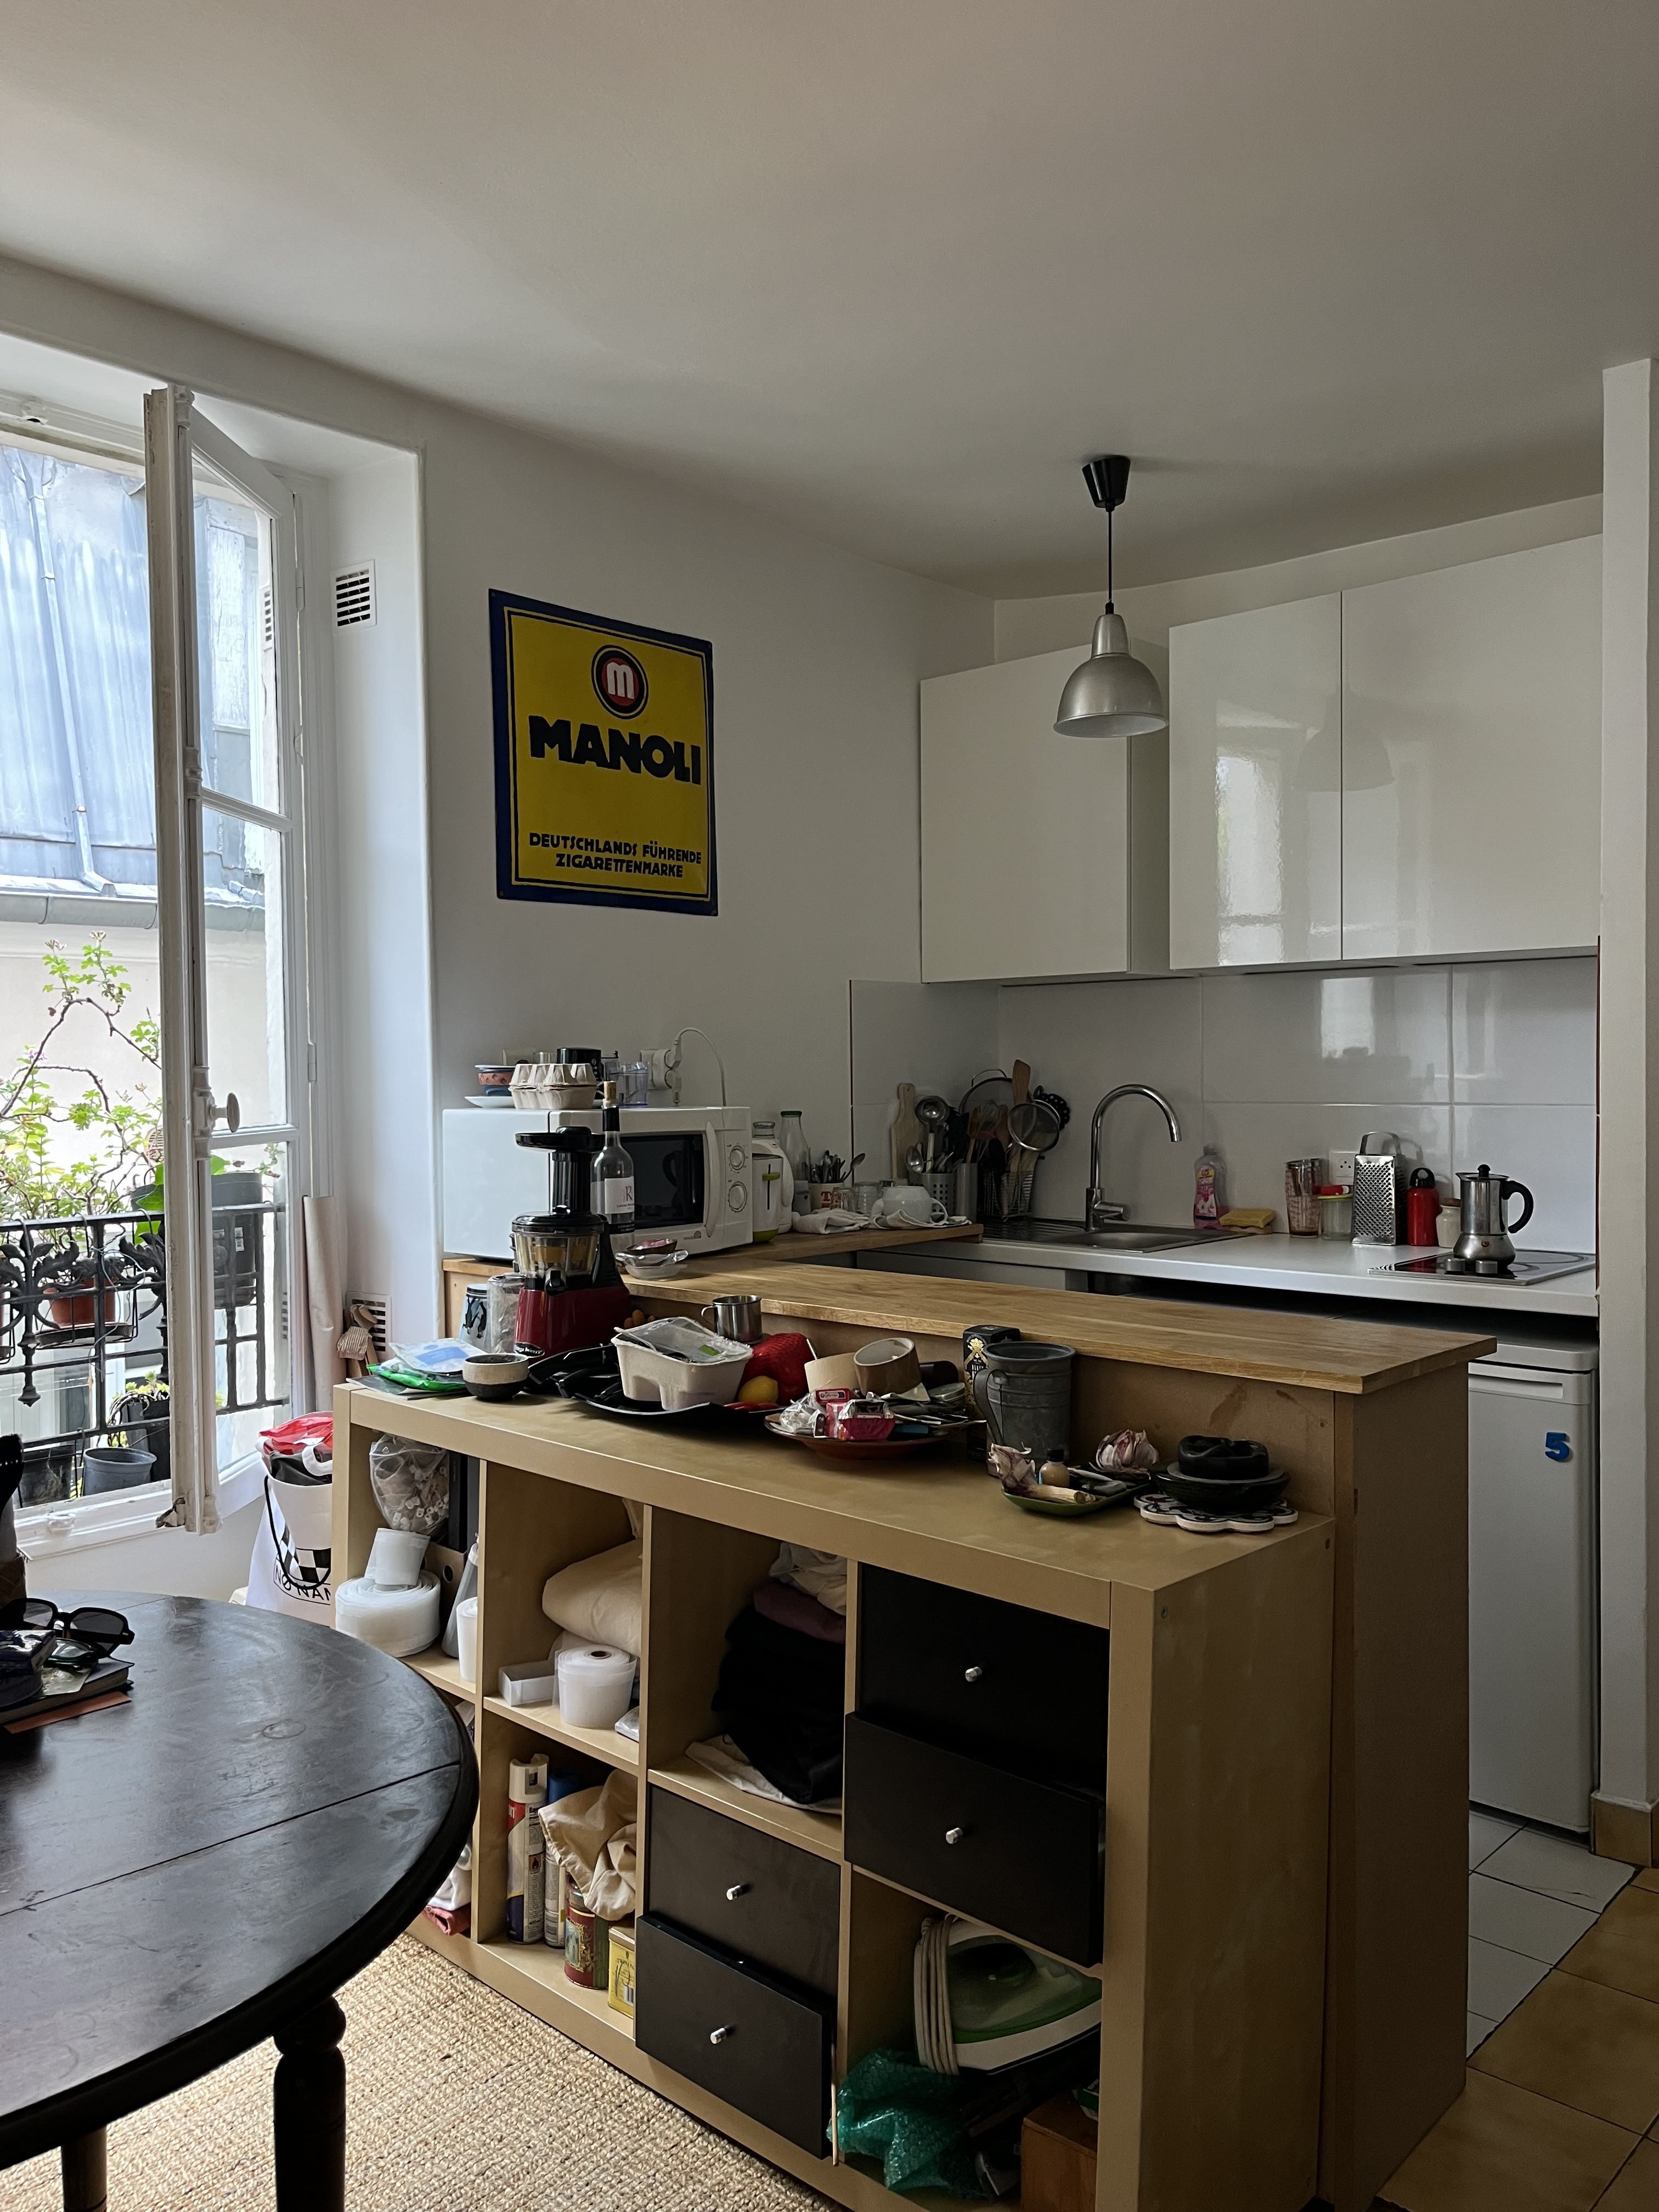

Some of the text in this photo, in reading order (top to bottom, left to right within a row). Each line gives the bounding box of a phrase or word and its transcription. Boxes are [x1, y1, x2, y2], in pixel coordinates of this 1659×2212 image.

[528, 715, 701, 785] MANOLI
[529, 832, 702, 864] DEUTSCHLANDS FÜHRENDE
[555, 853, 683, 878] ZIGARETTENMARKE
[1545, 1432, 1570, 1462] 5
